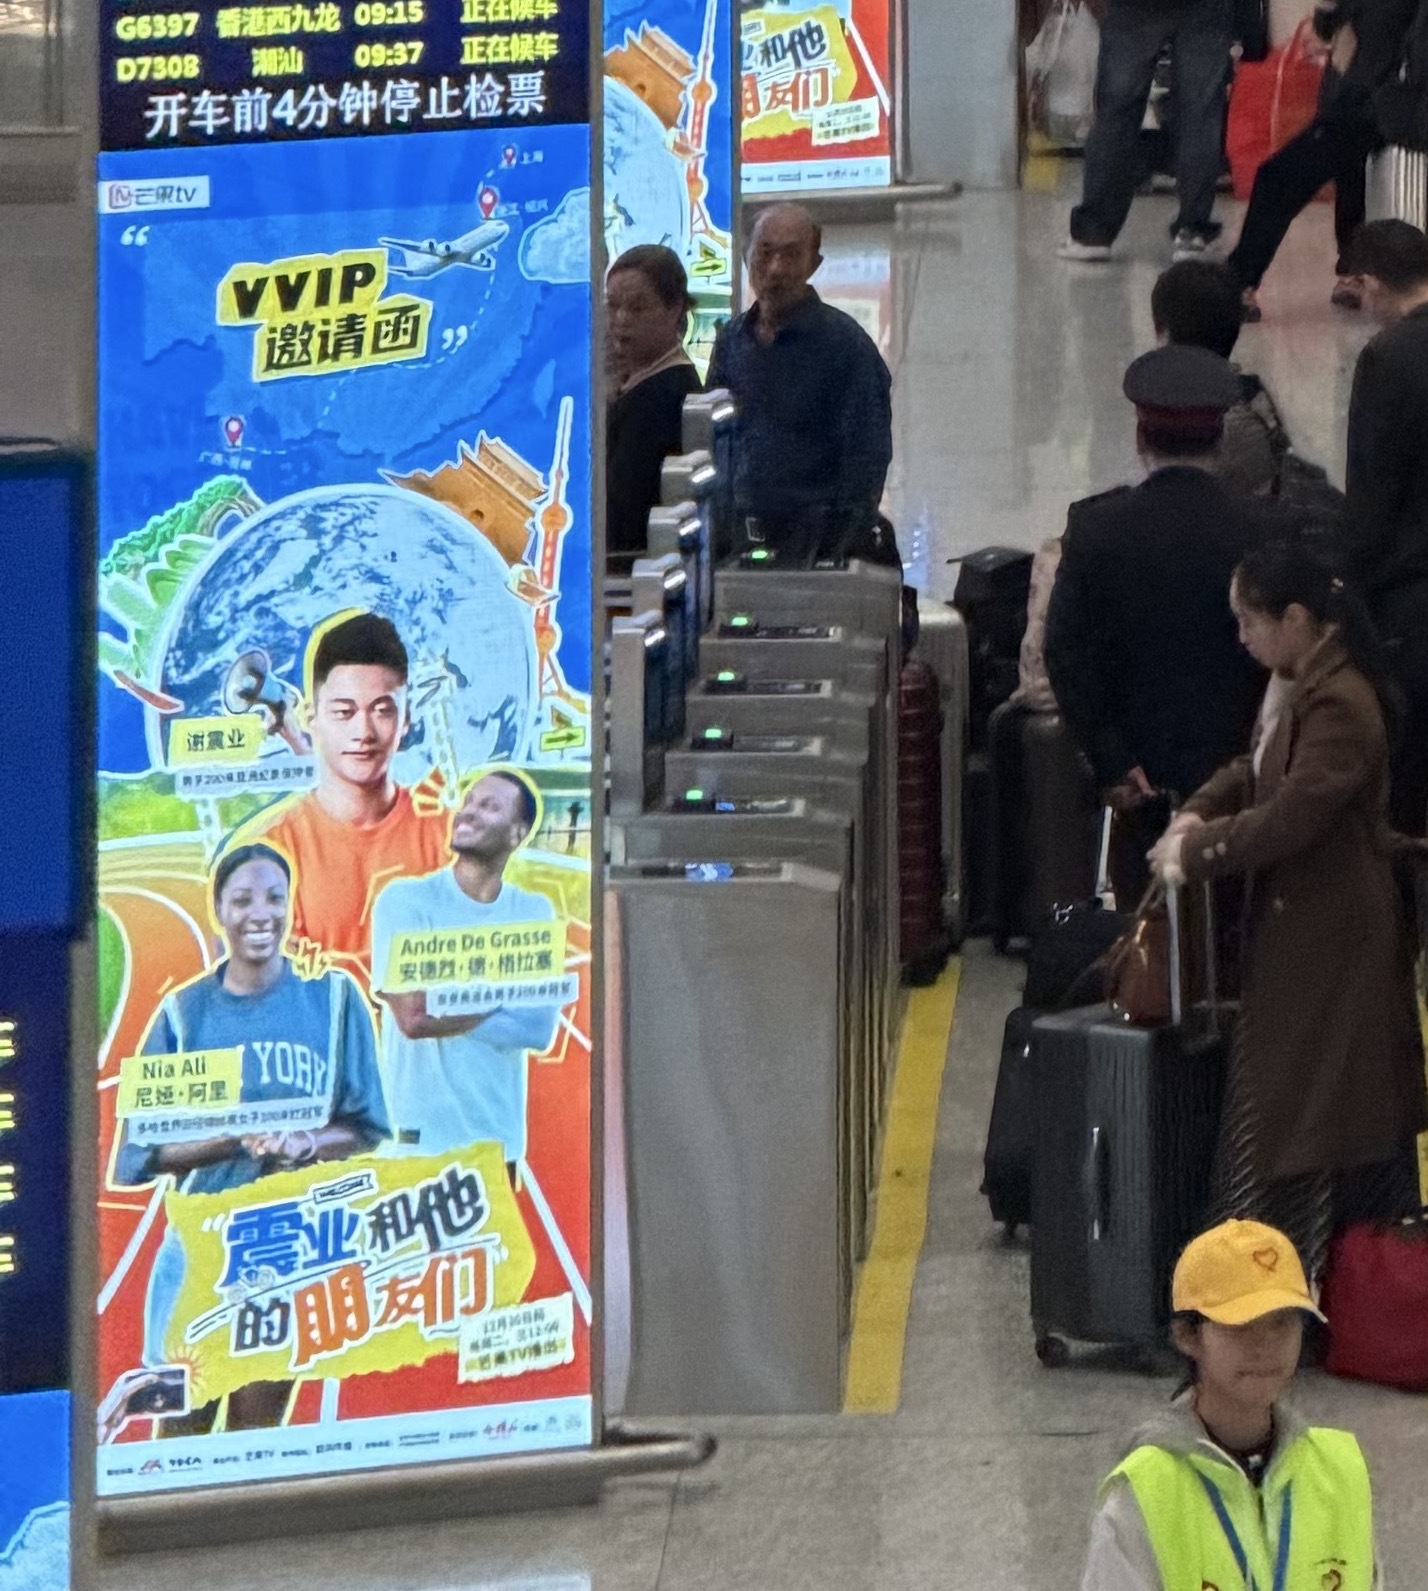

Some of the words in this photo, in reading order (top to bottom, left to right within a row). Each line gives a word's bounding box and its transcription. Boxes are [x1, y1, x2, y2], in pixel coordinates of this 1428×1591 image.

[116, 12, 199, 41] G6397
[216, 3, 341, 38] 香港西九龙
[354, 0, 424, 26] 09:15
[251, 47, 304, 77] 潮汕
[354, 41, 425, 68] 09:37
[460, 33, 560, 65] 正在候车
[145, 70, 546, 139] 开车前4分钟停止检票
[231, 262, 377, 319] VVIP
[262, 304, 422, 373] 邀请函
[400, 933, 456, 959] Andre
[461, 931, 486, 953] De
[490, 926, 552, 949] Grasse
[142, 1058, 176, 1080] Nia
[181, 1055, 207, 1076] Ali
